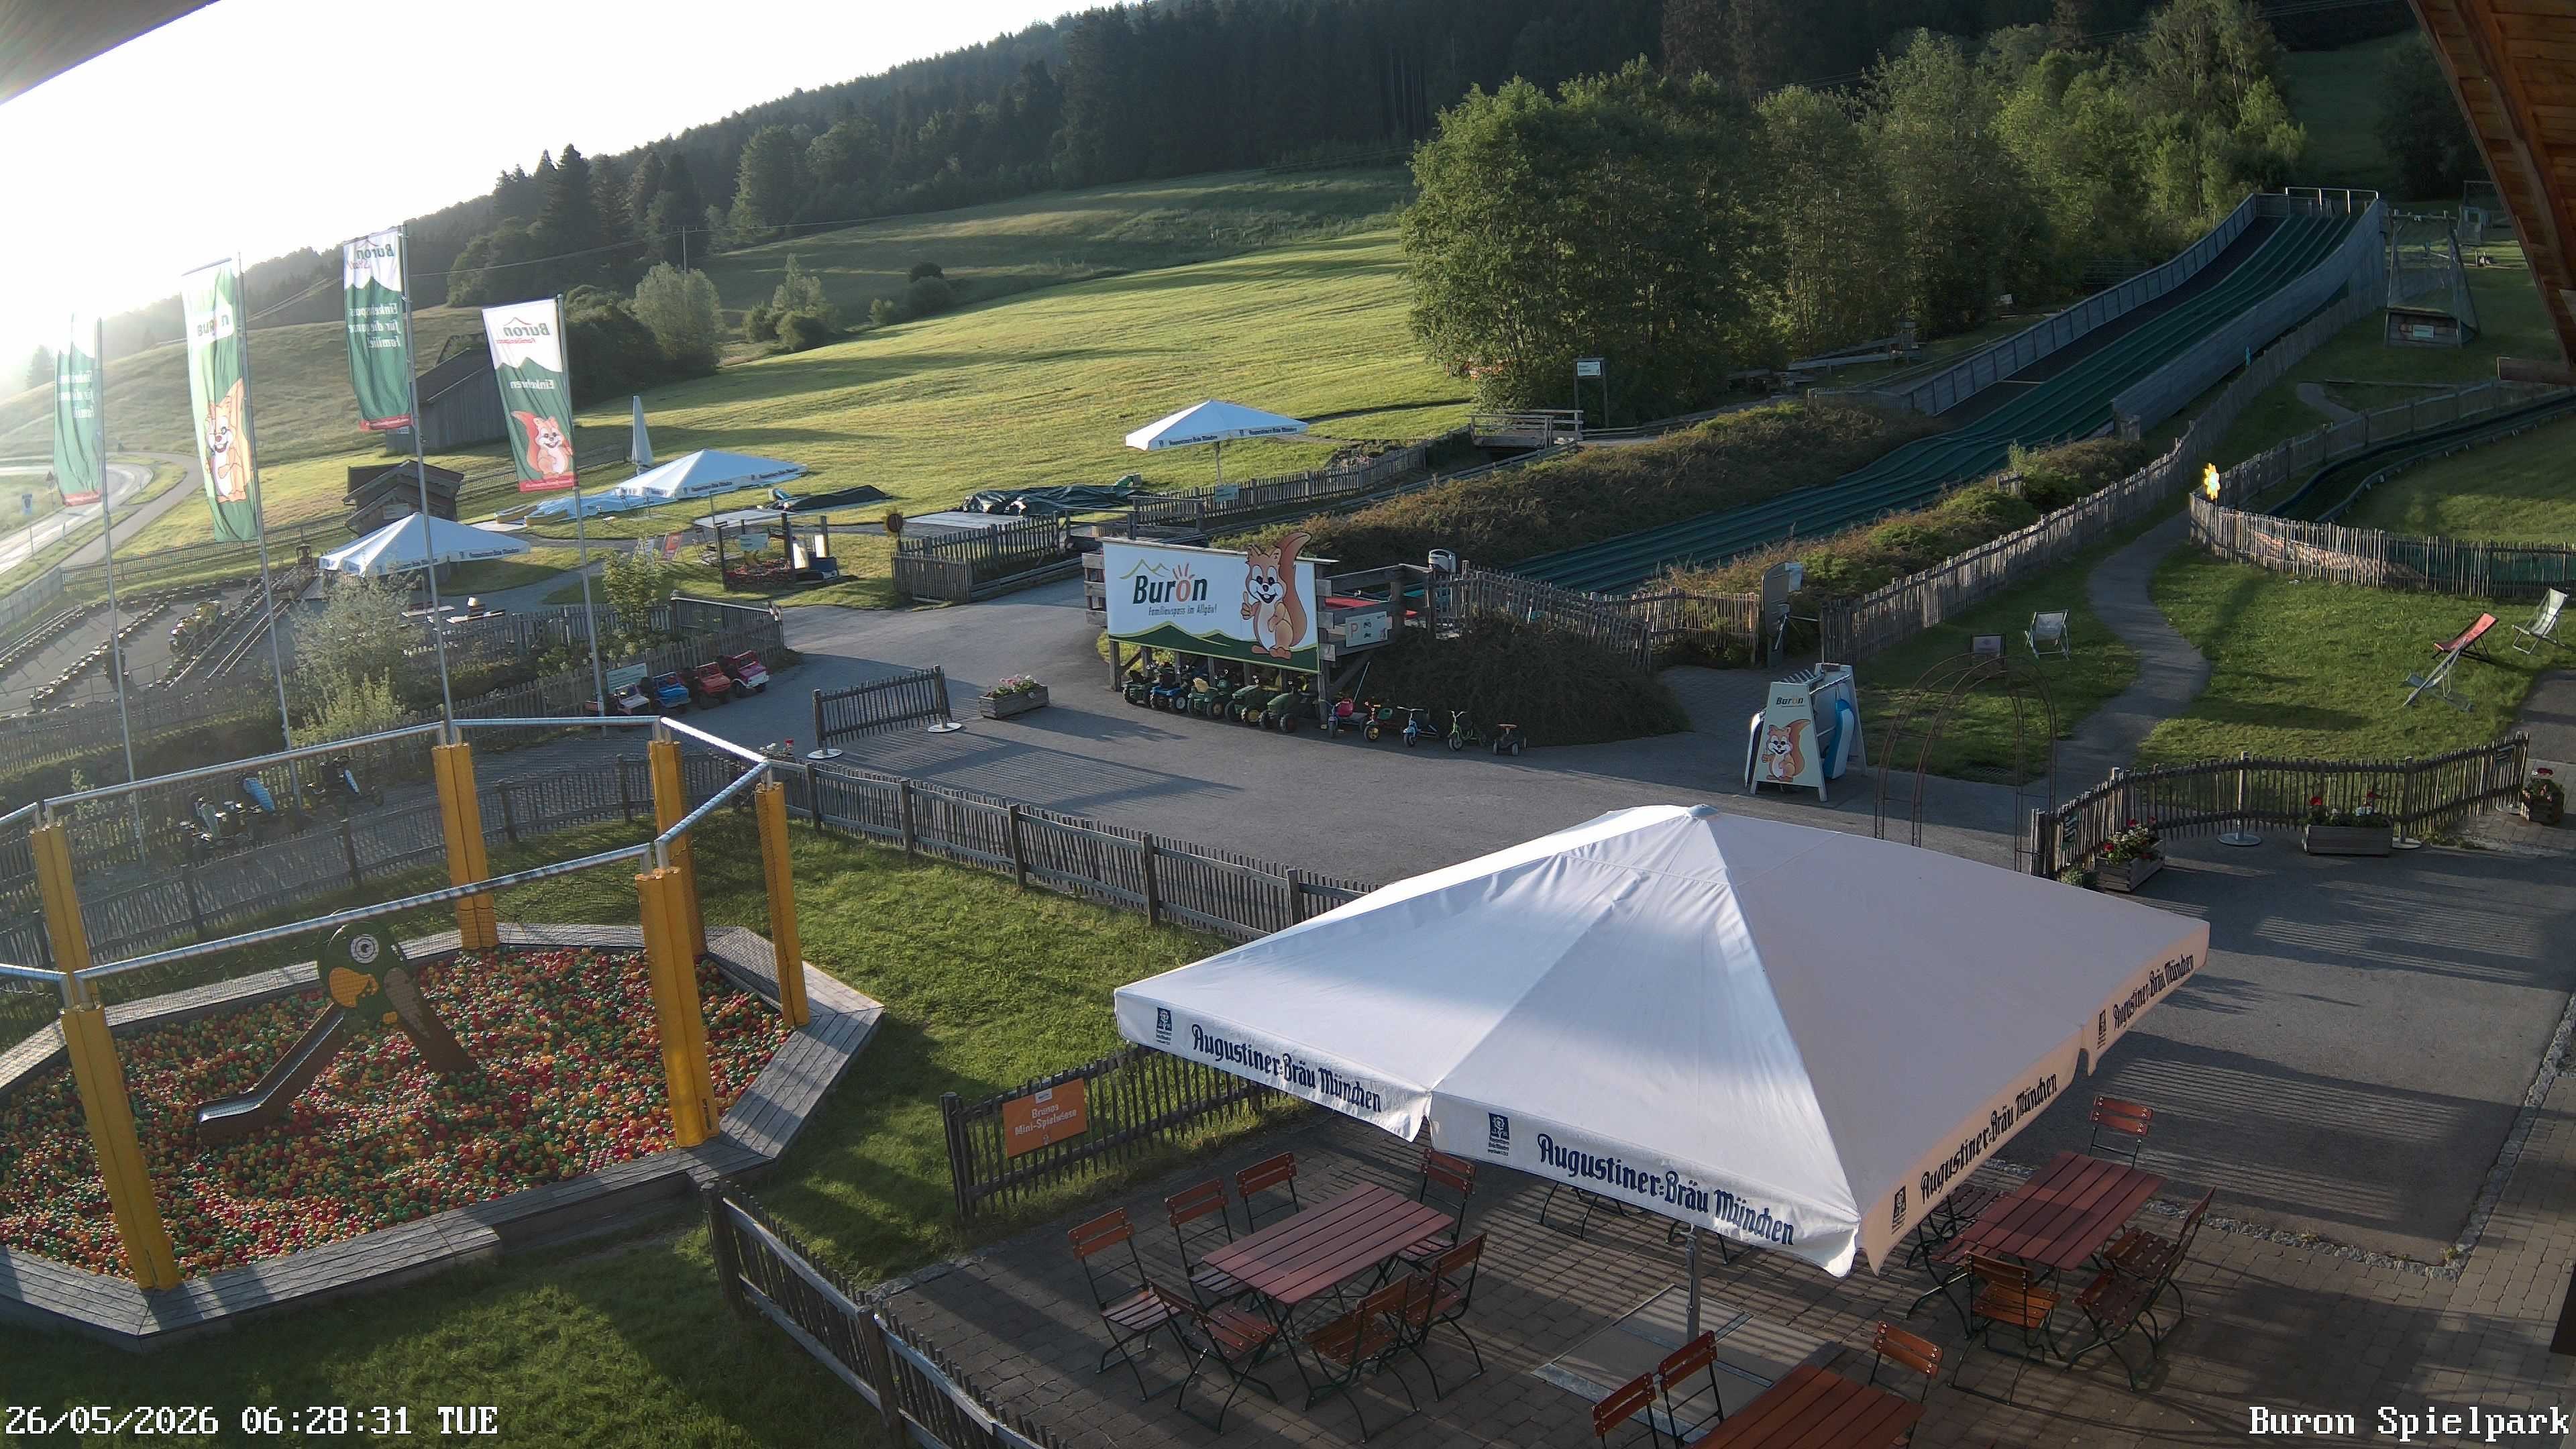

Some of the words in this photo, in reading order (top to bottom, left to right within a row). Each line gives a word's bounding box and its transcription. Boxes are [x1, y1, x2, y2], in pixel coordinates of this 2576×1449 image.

[1132, 574, 1208, 604] Buron
[1776, 697, 1804, 705] Buron
[1318, 1067, 1382, 1113] München
[2015, 1073, 2058, 1122] München
[1714, 1189, 1794, 1246] München
